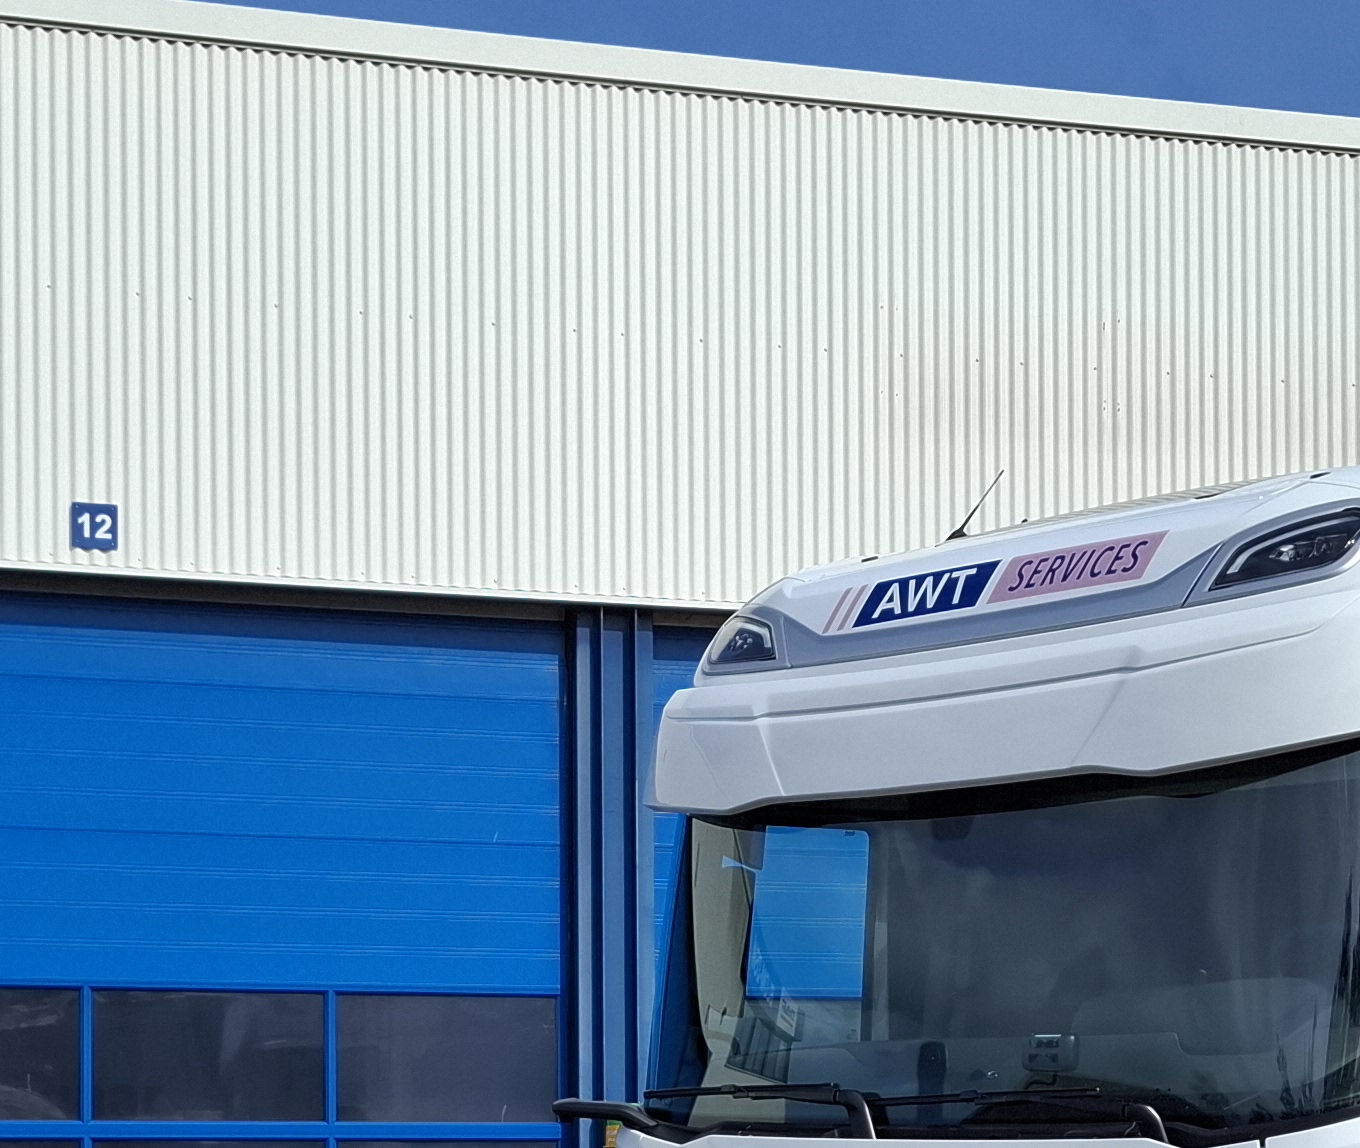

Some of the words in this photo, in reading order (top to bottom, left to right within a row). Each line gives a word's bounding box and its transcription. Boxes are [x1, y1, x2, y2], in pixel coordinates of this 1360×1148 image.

[77, 511, 113, 540] 12
[871, 567, 978, 619] AWT
[1007, 539, 1150, 593] SERVICES
